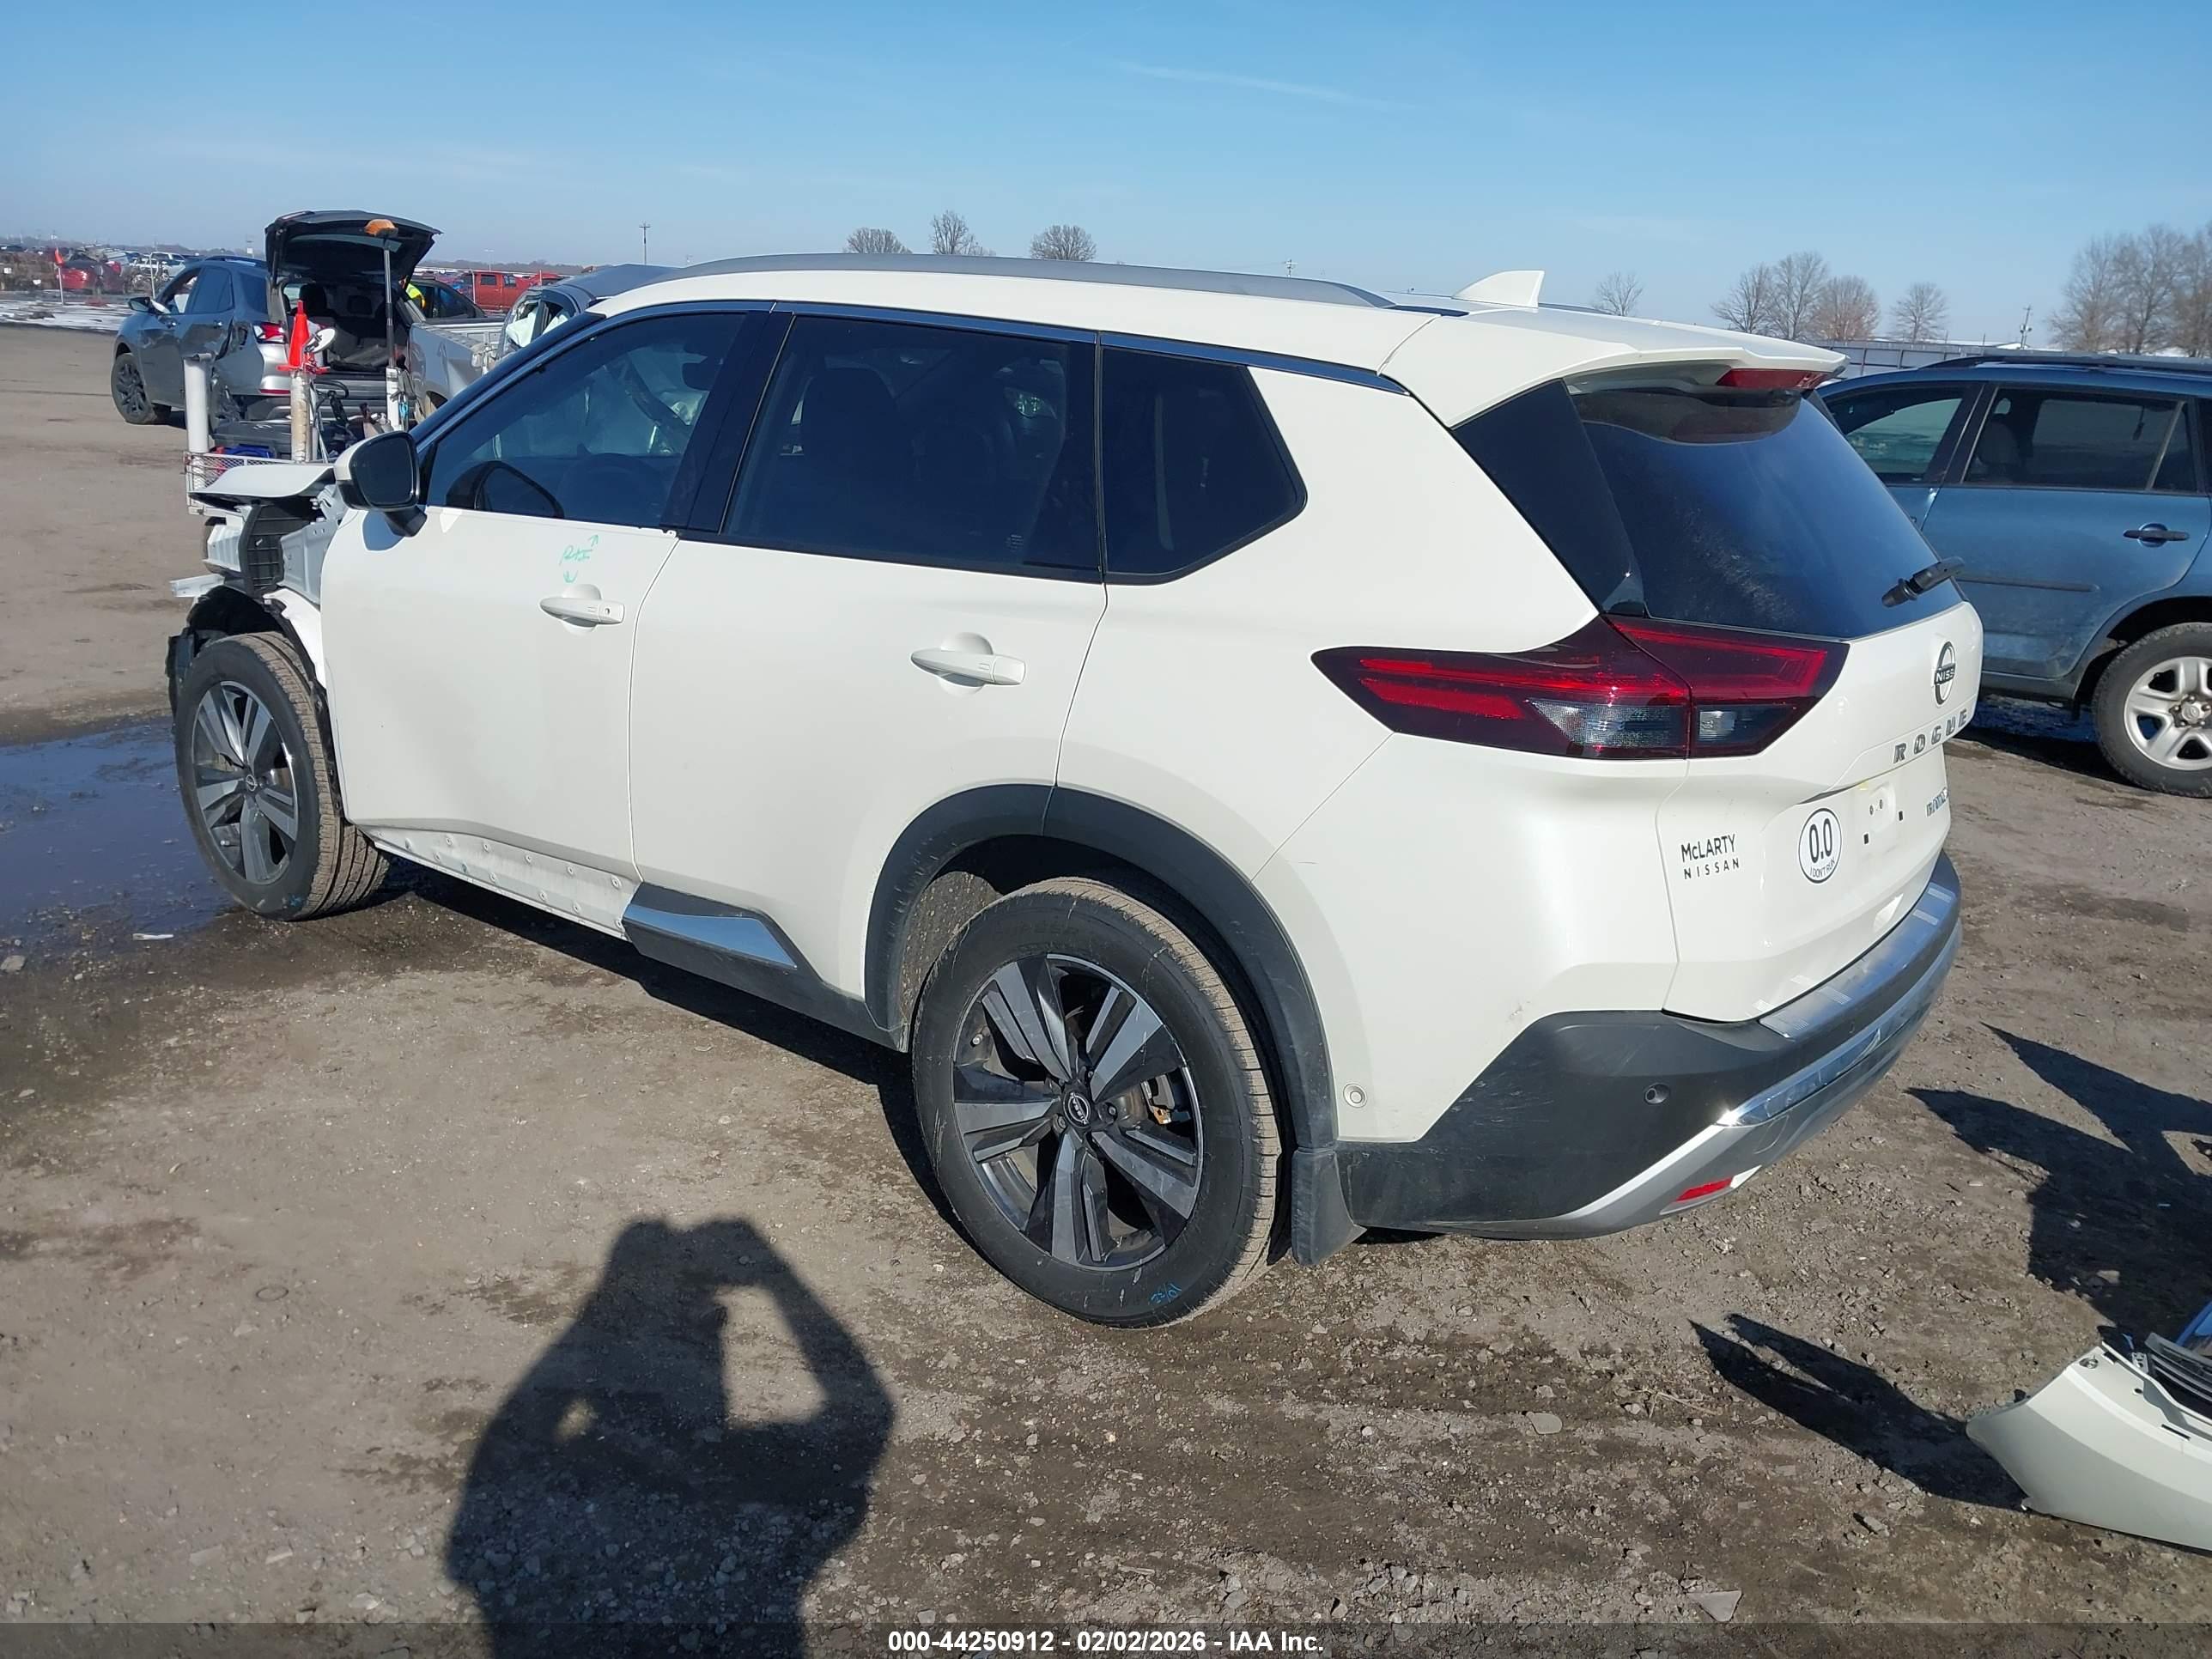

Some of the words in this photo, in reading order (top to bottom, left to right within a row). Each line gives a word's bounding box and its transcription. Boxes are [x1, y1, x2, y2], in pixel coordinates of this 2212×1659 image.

[1893, 708, 1967, 764] ROGUE
[1680, 833, 1735, 863] McLARTY
[1808, 817, 1832, 864] 0.0
[1683, 857, 1740, 880] NISSAN
